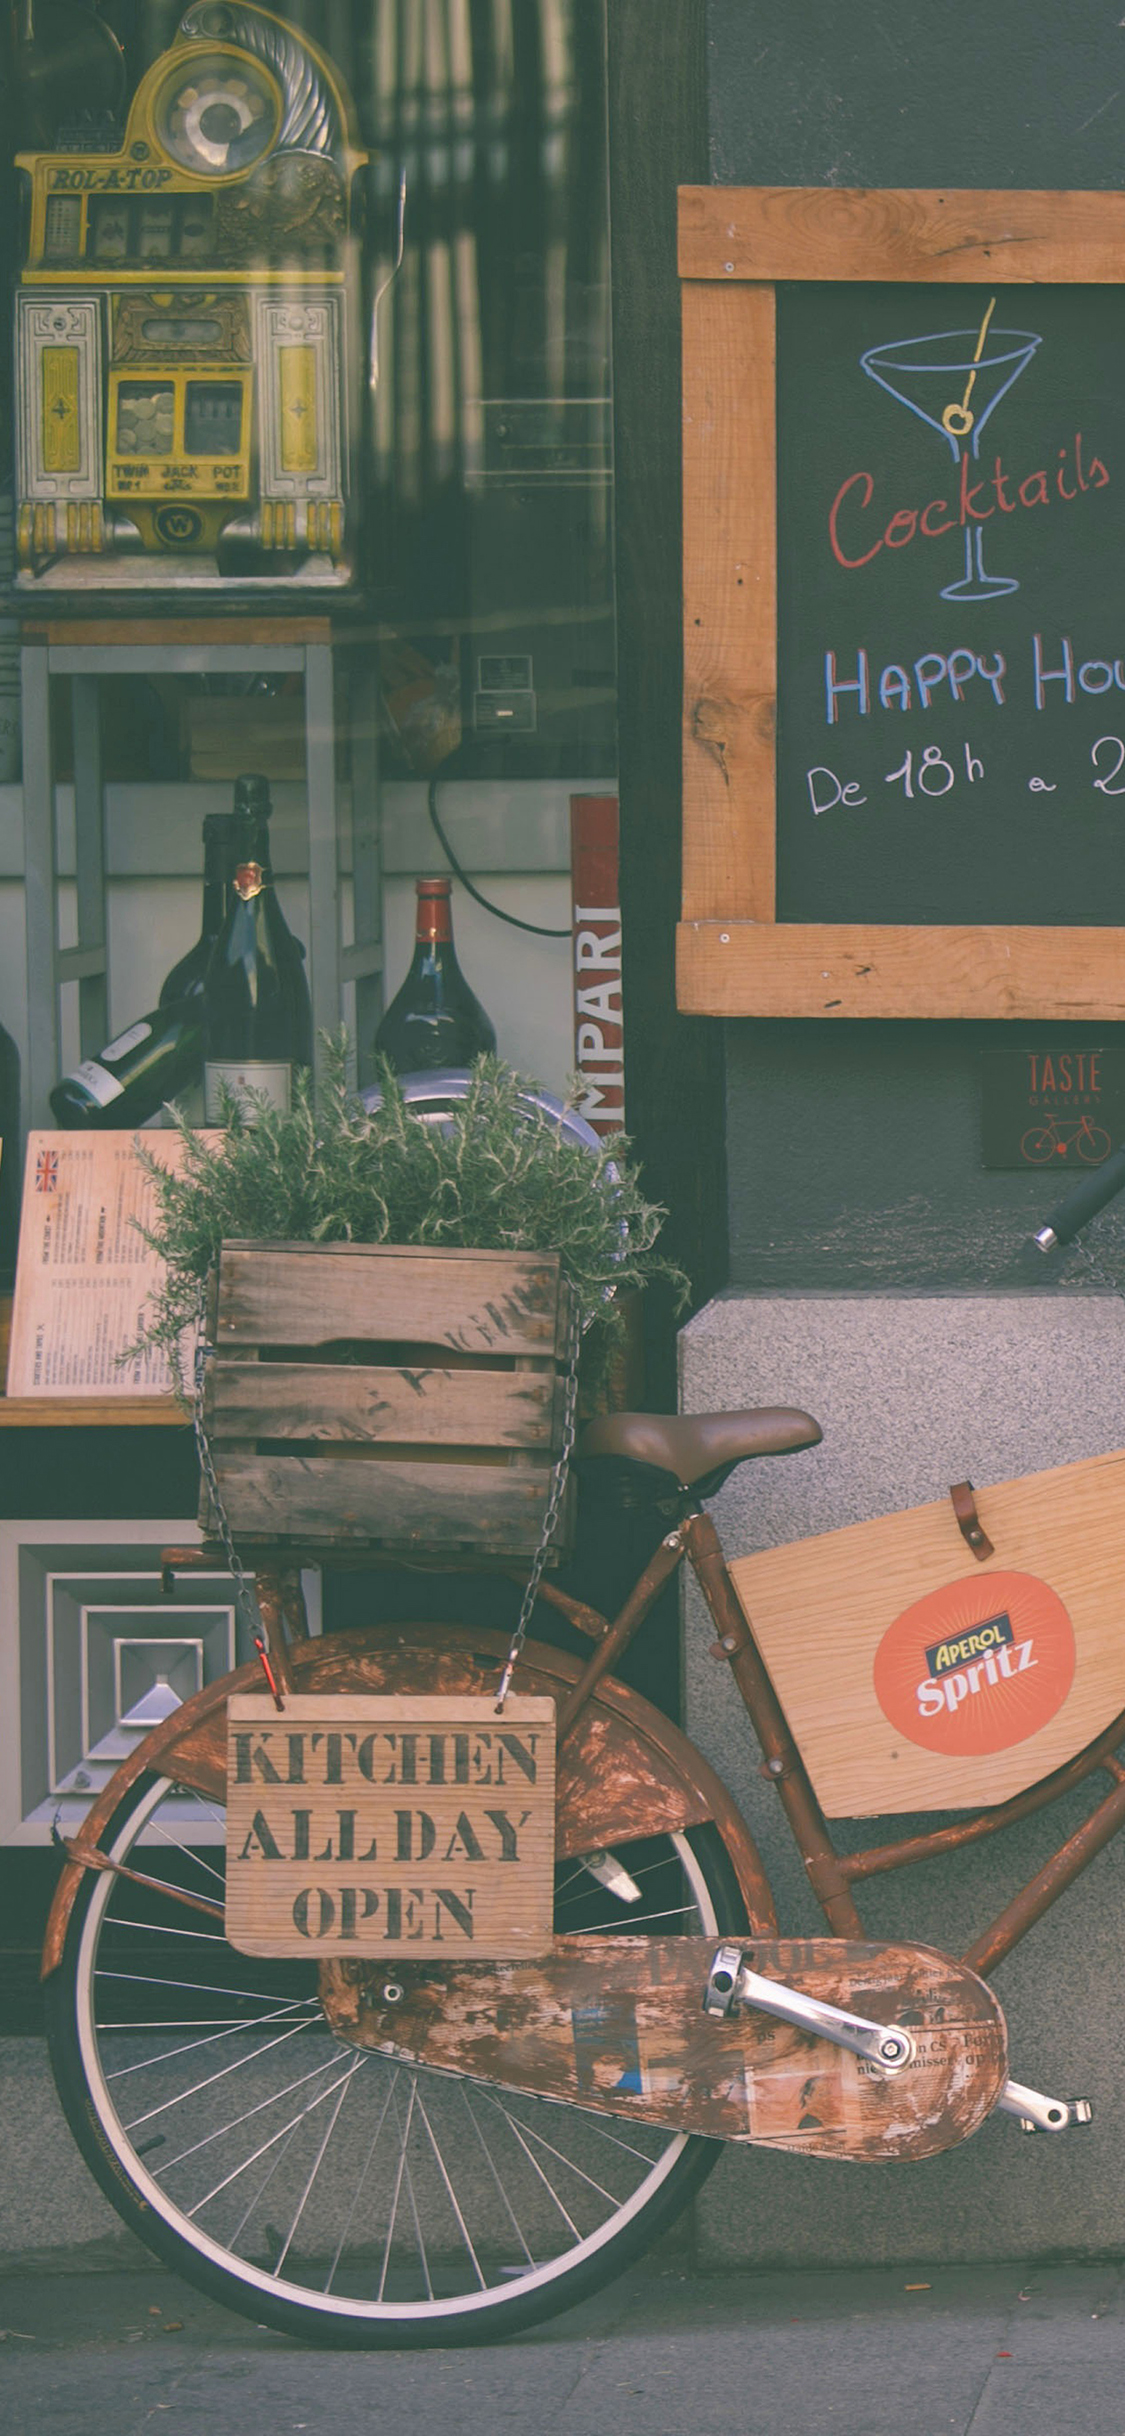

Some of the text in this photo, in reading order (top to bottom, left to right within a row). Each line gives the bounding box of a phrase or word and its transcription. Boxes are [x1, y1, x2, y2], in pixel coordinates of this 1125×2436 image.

[53, 168, 173, 190] ROL-A-TOP
[114, 465, 240, 479] TWIN JACK POT
[829, 433, 1110, 568] Cocktails
[825, 649, 1006, 724] HAPPY
[808, 767, 867, 815] De
[575, 905, 625, 1128] MPARI
[1028, 1053, 1102, 1092] TASTE
[1028, 1096, 1102, 1106] GALLERY
[935, 1626, 1006, 1671] APEROL
[916, 1639, 1039, 1717] Spritz
[231, 1733, 541, 1785] KITCHEN
[237, 1809, 532, 1861] ALL DAY
[292, 1887, 477, 1940] OPEN
